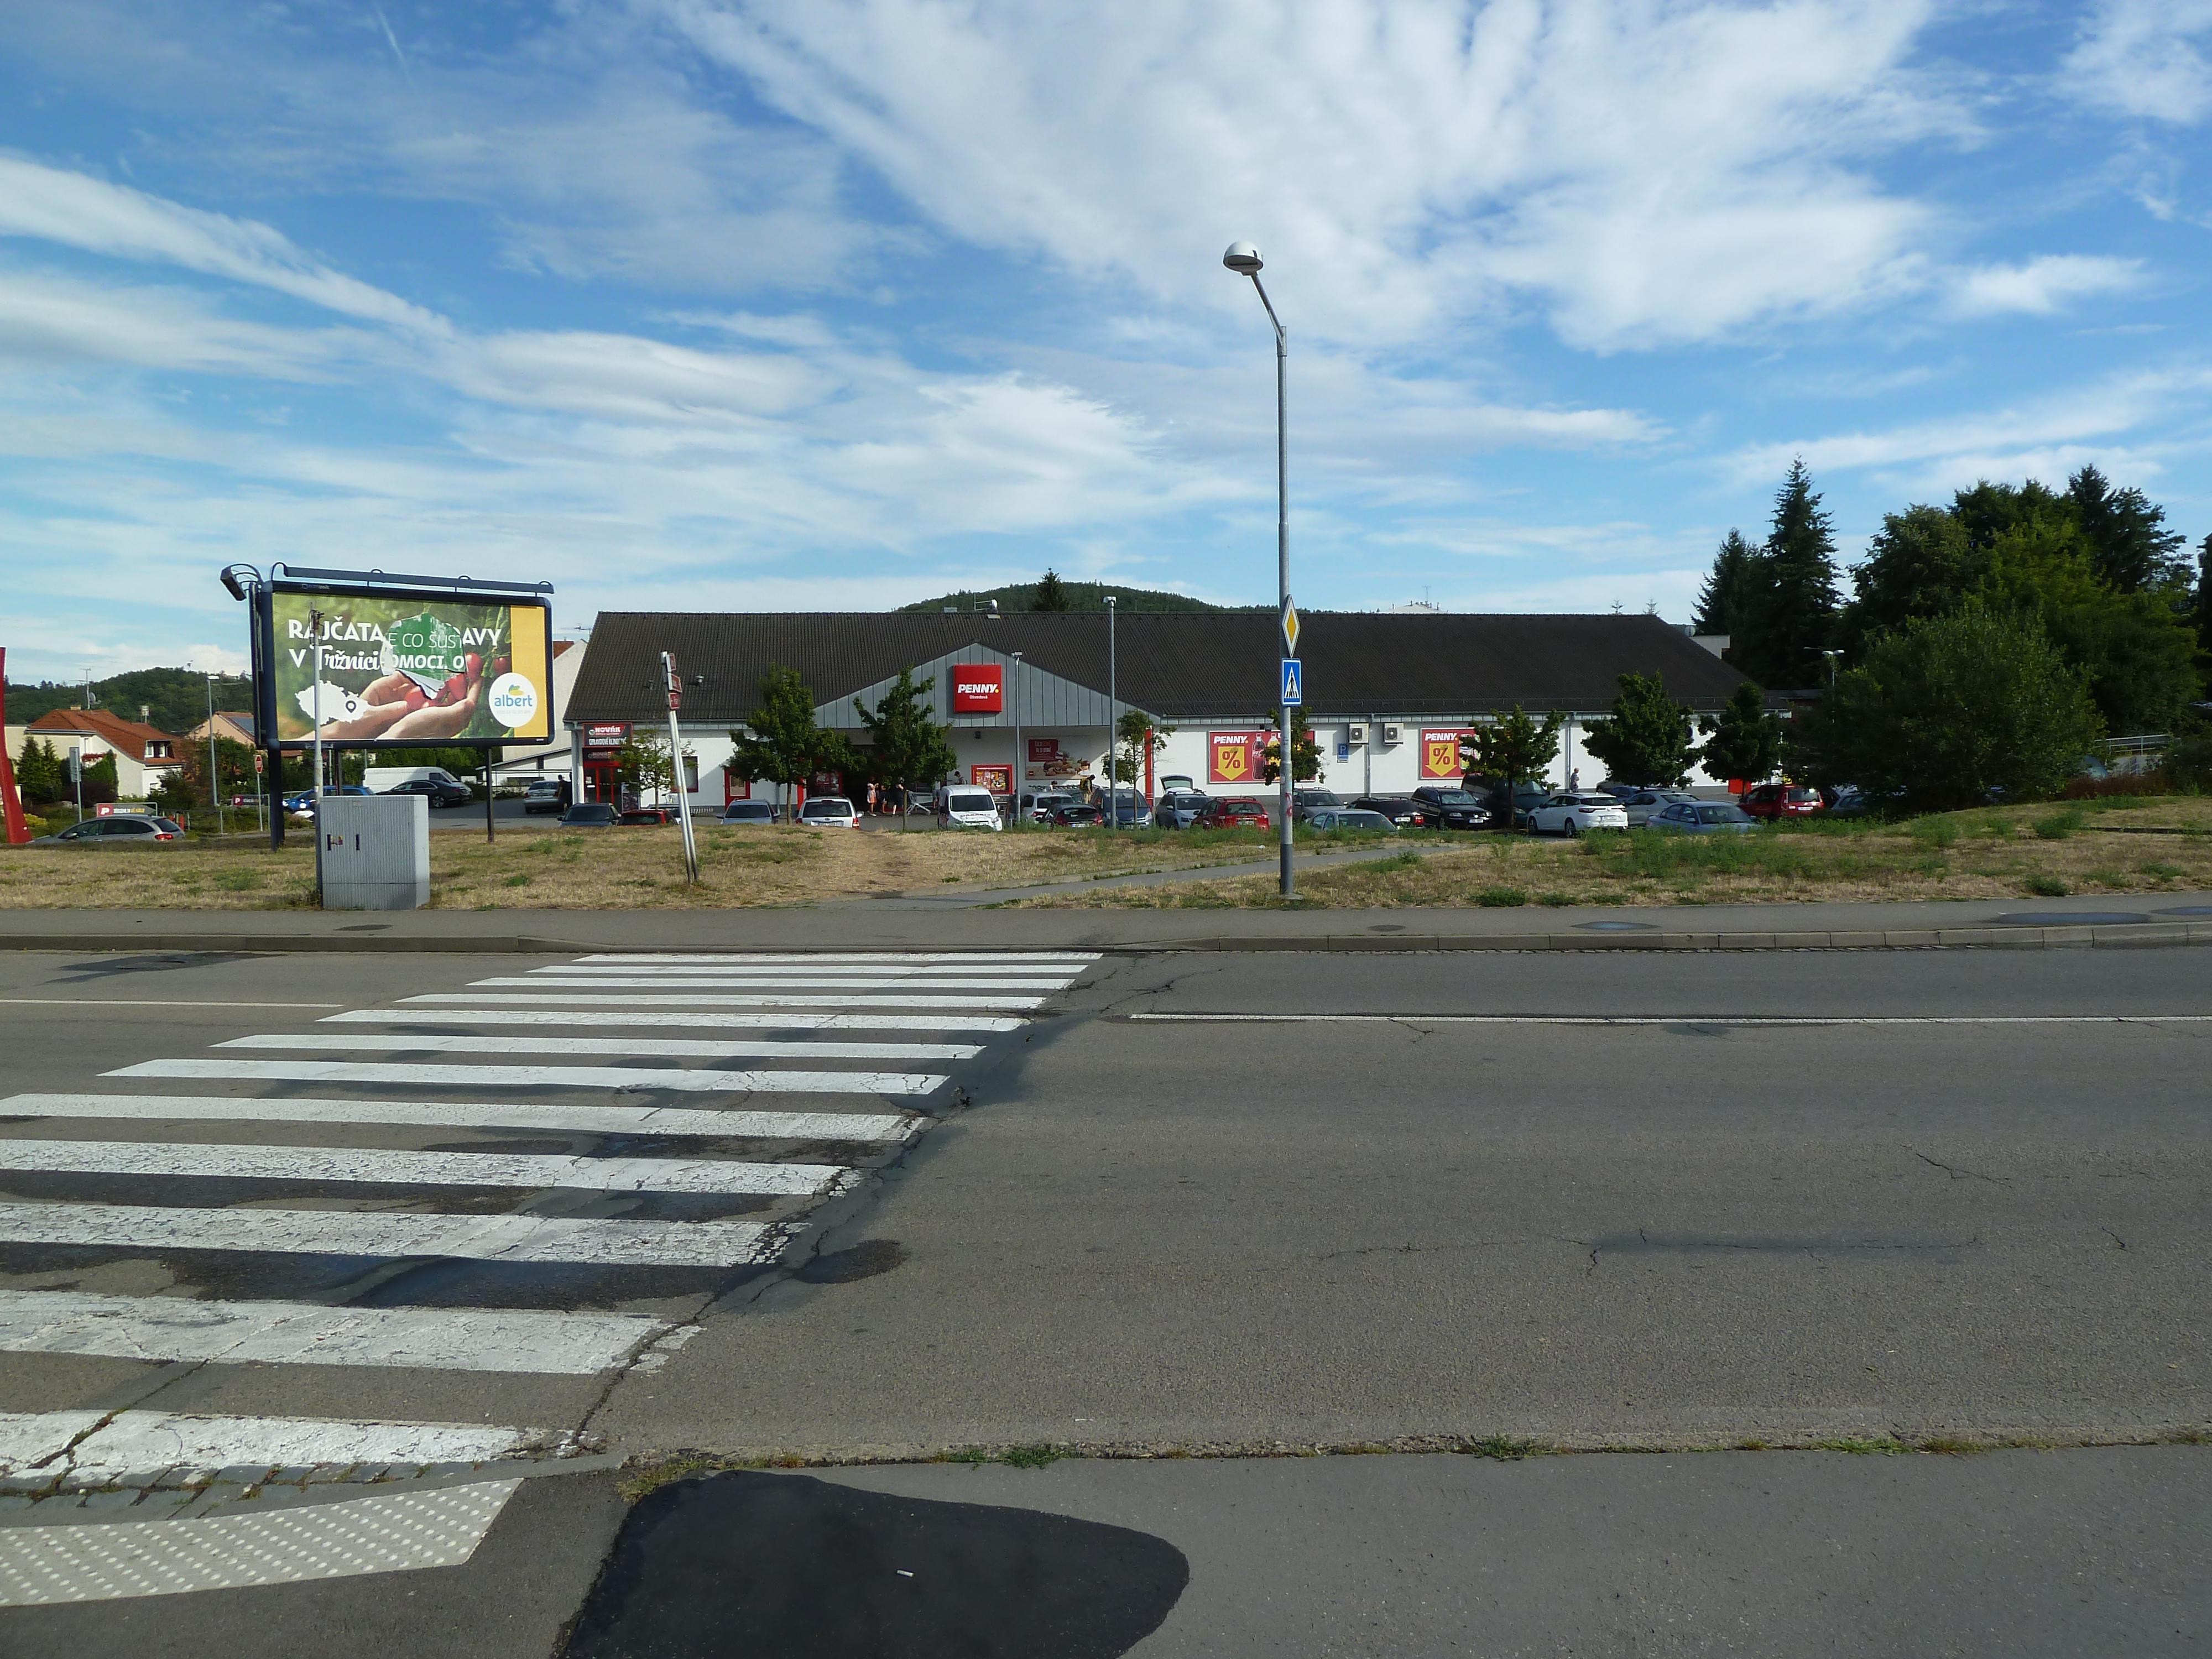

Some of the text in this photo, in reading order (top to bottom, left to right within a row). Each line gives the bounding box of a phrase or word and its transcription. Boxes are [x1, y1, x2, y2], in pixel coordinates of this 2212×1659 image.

[402, 633, 424, 648] CO
[461, 627, 502, 646] AVY
[288, 644, 380, 670] V Tržnici
[494, 694, 533, 707] albert
